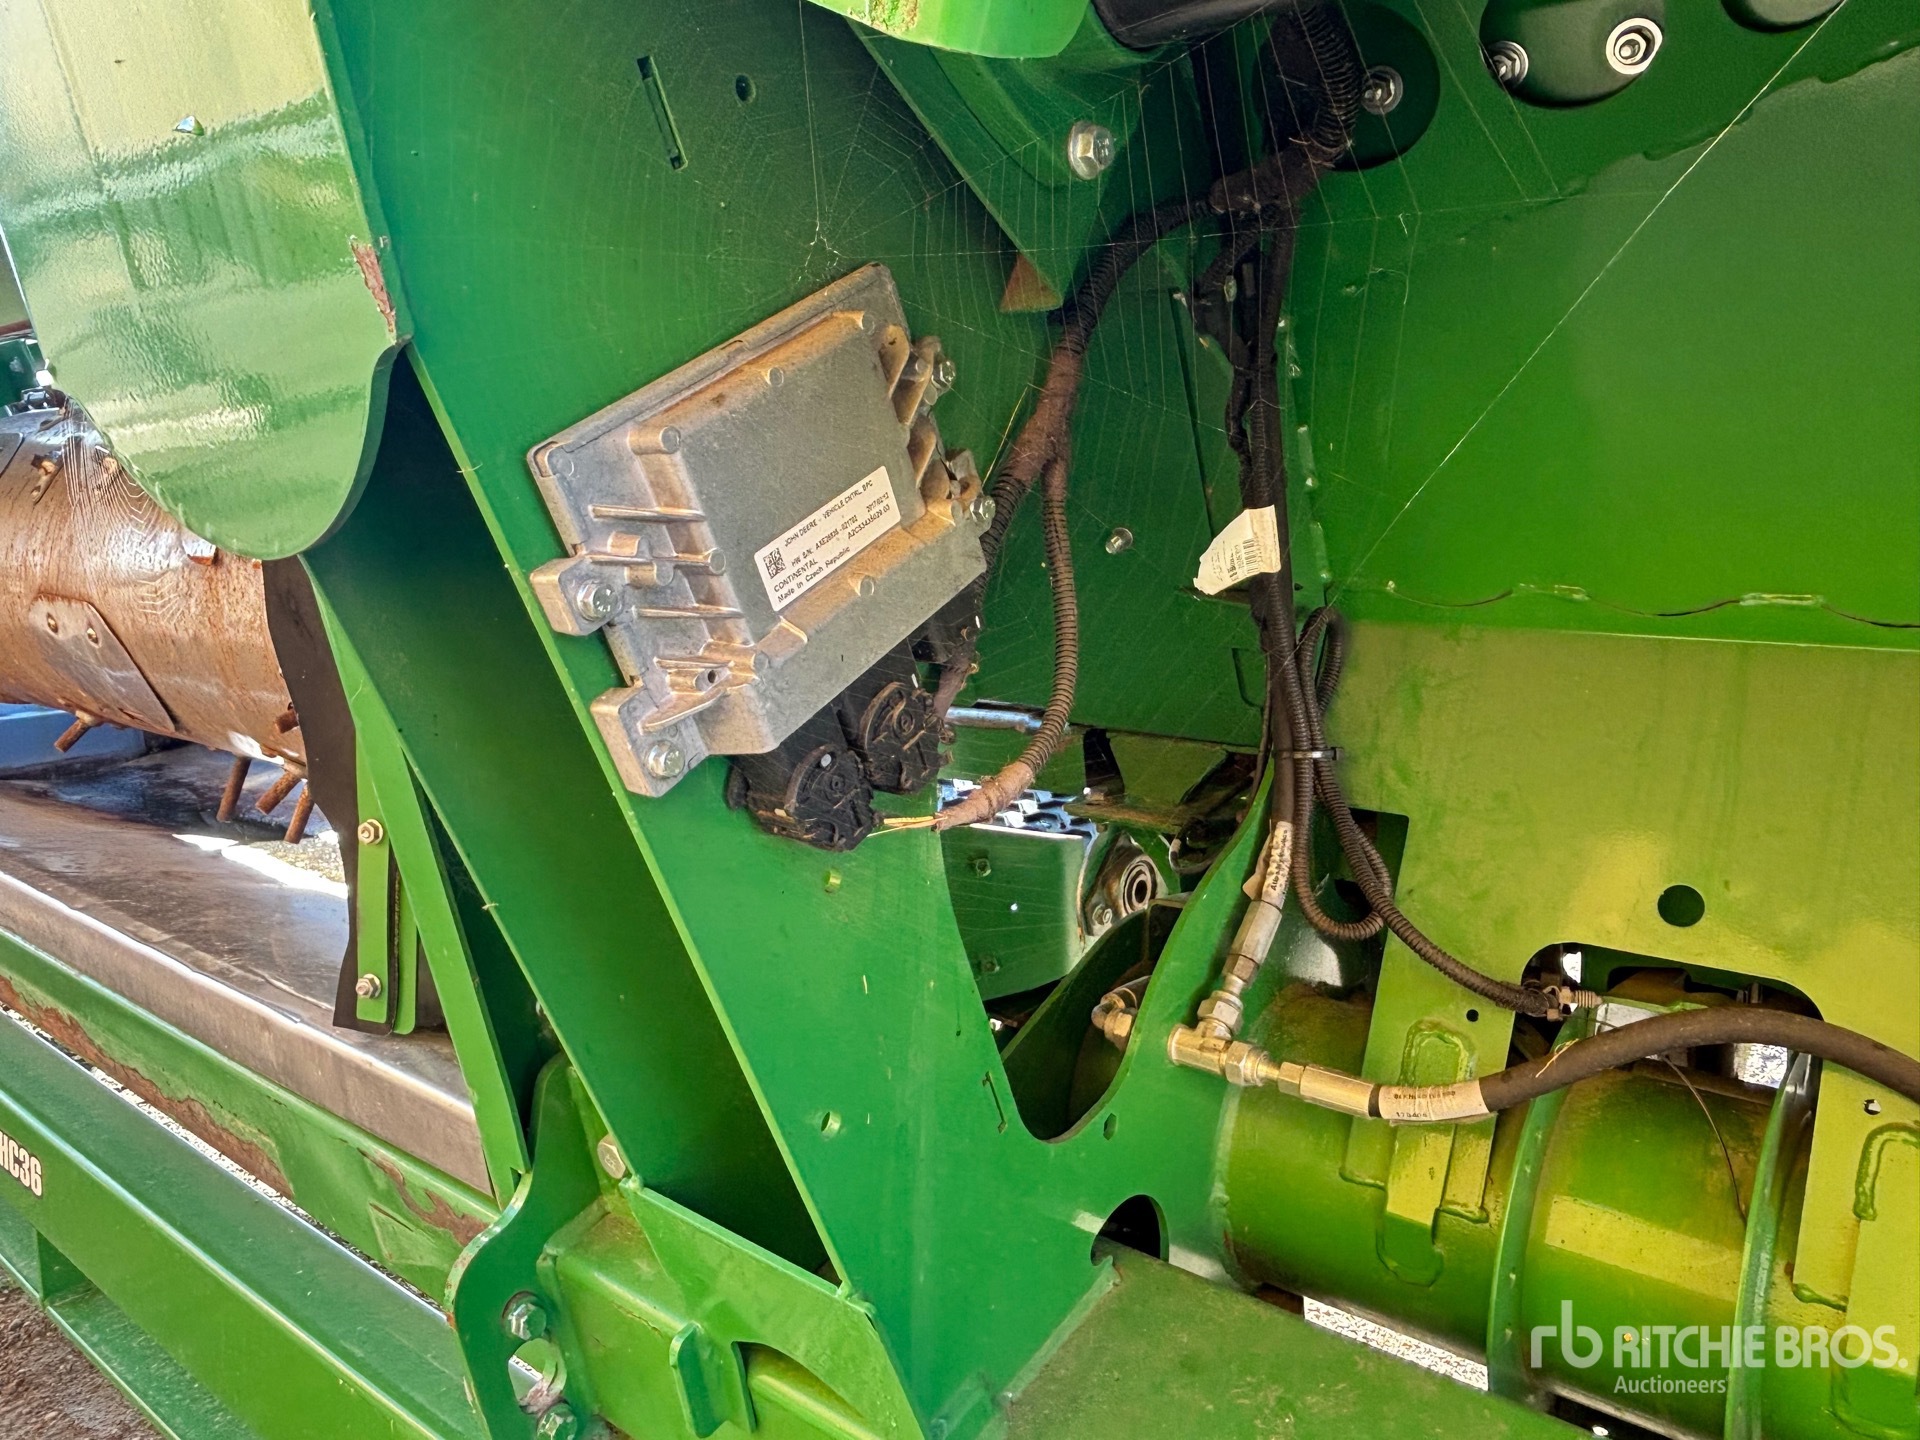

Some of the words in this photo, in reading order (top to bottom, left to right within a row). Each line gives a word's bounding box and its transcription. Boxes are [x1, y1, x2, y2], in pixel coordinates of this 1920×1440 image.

[784, 532, 799, 547] JOHN
[799, 518, 818, 537] DEERE
[822, 499, 845, 519] VEHICLE
[773, 558, 818, 593] CONTINENTAL
[777, 587, 795, 603] Made
[805, 566, 824, 582] Czech
[825, 546, 850, 568] Republic
